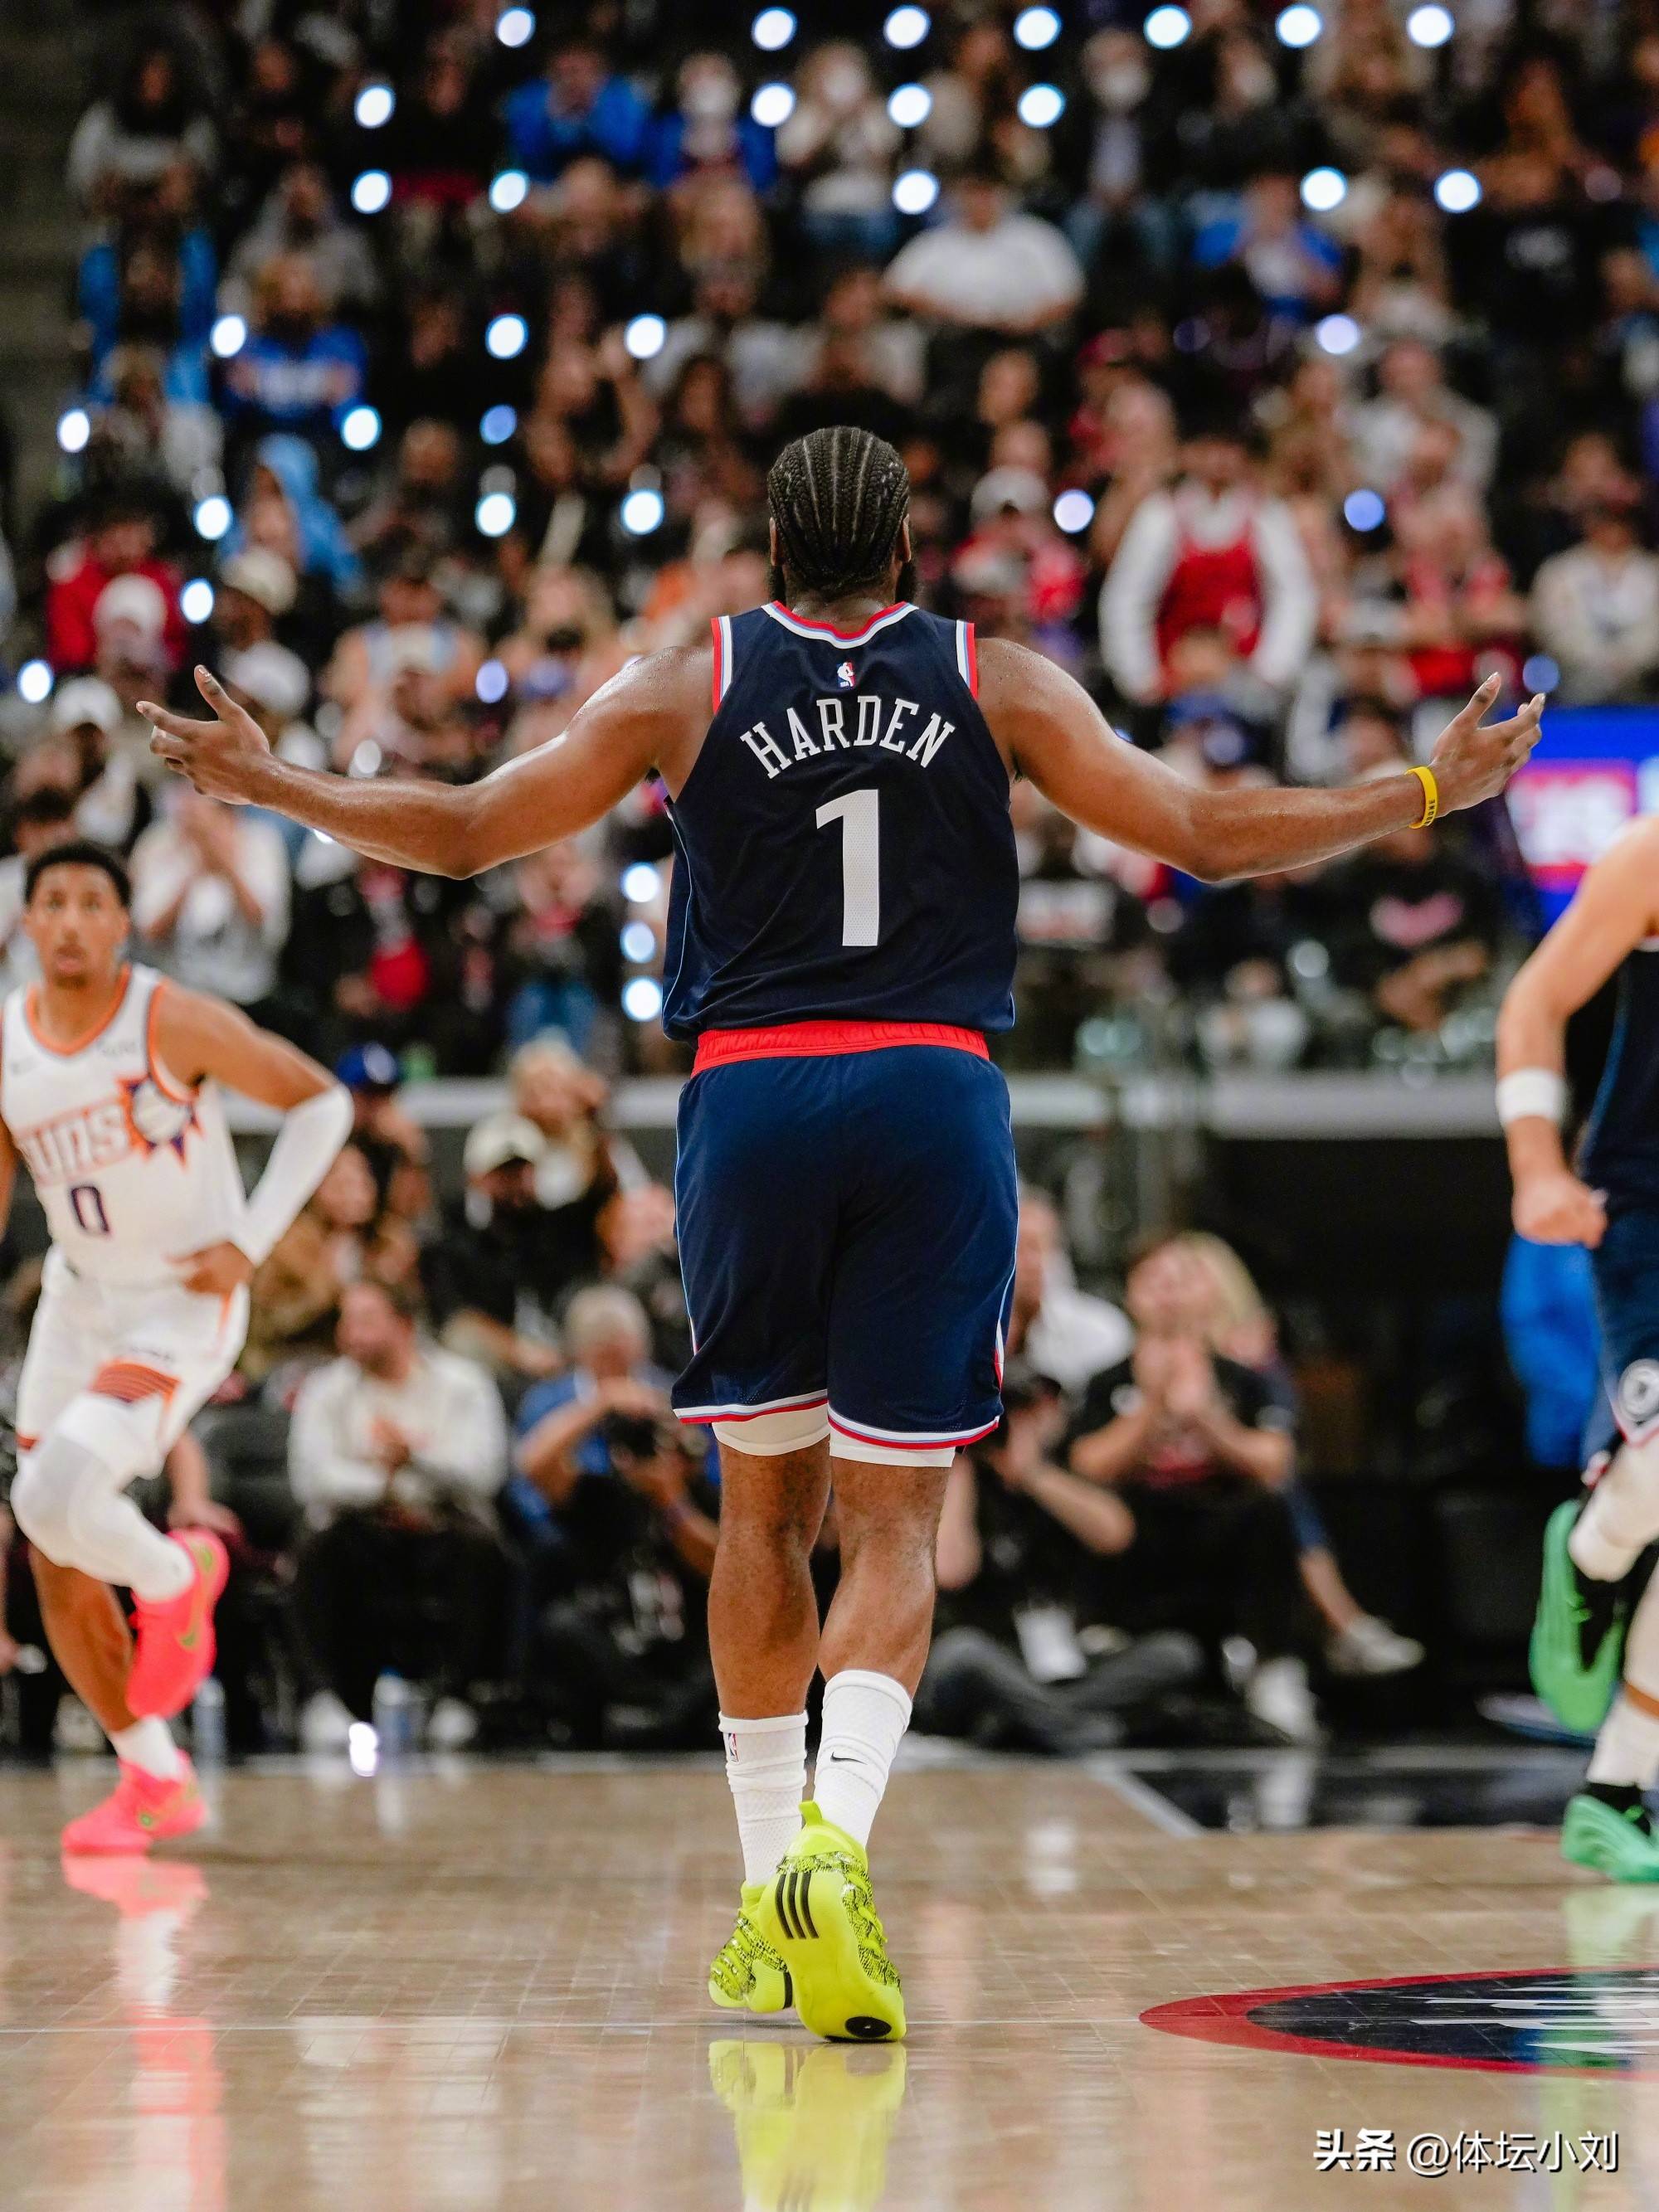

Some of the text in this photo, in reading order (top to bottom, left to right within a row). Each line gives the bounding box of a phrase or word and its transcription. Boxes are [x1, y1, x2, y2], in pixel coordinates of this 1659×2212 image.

[740, 695, 956, 779] HARDEN
[815, 789, 879, 946] 1
[70, 1184, 111, 1237] 0
